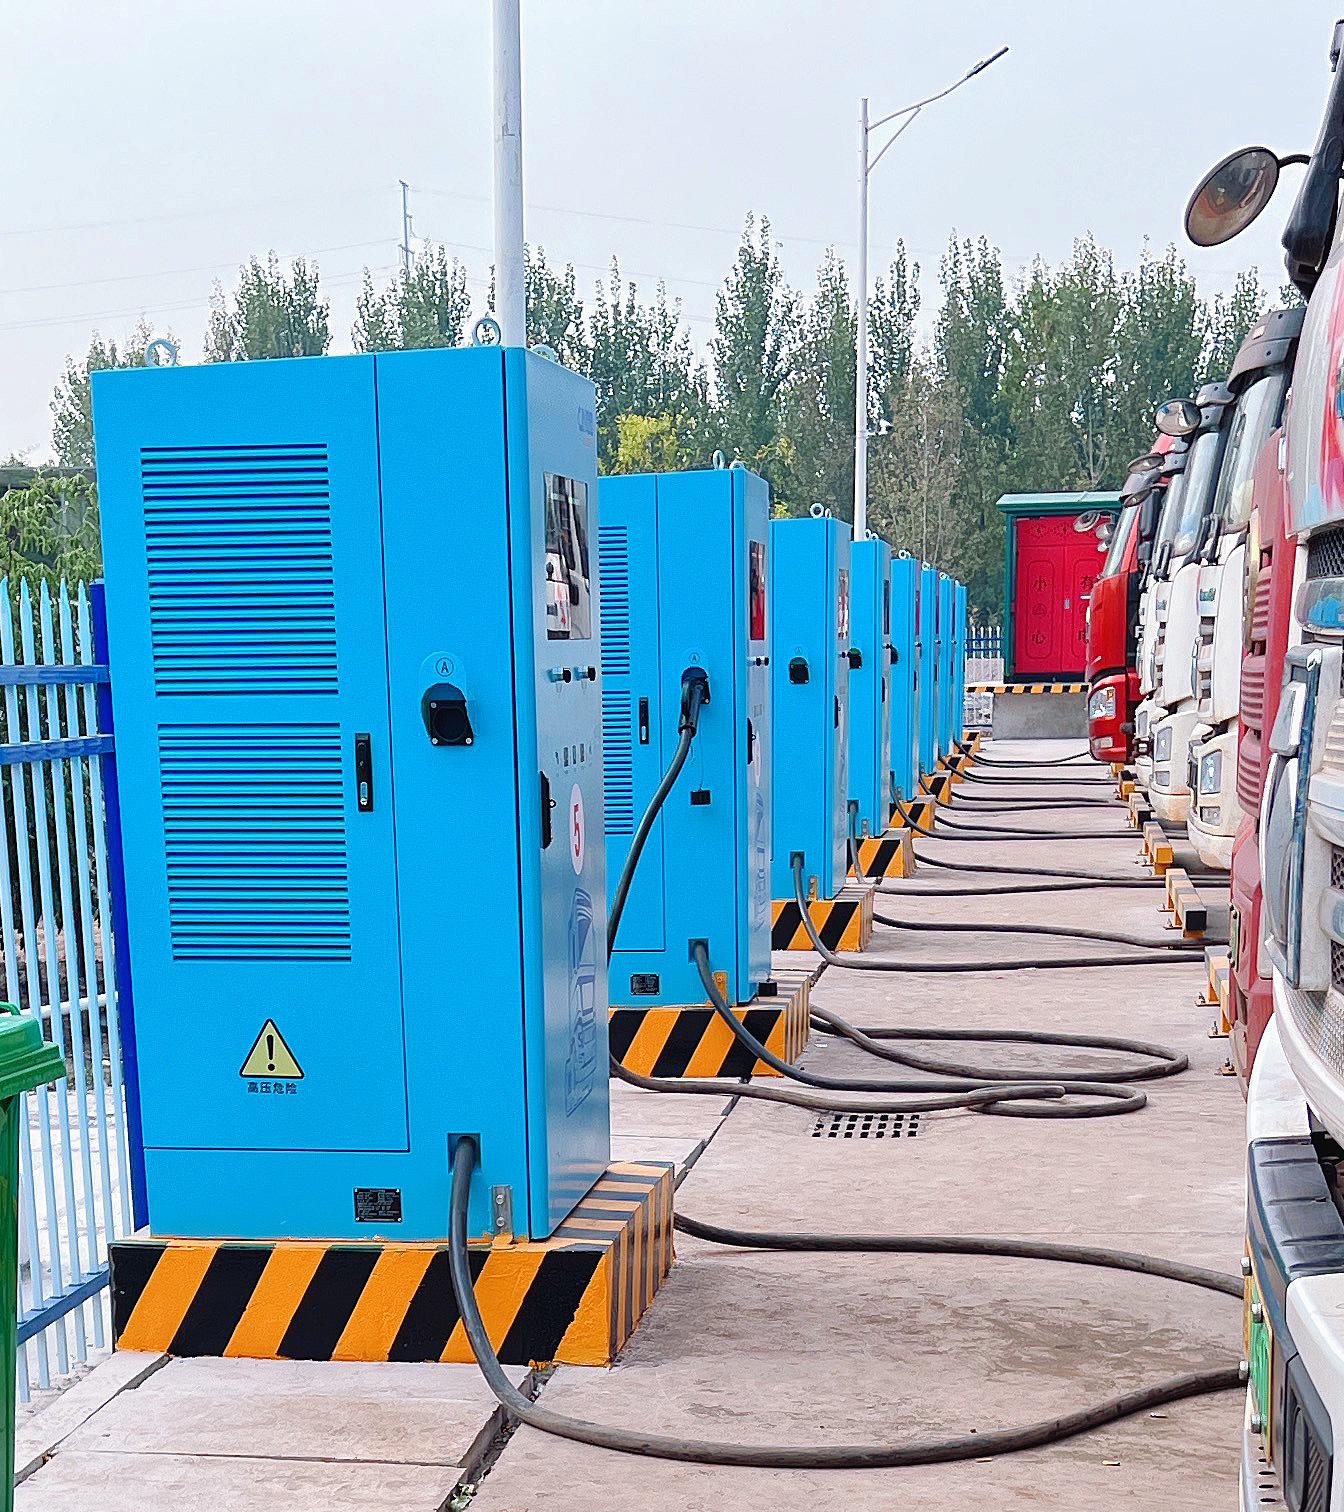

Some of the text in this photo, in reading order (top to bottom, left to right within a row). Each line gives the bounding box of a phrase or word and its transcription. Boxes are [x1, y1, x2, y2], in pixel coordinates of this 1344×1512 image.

[573, 803, 581, 858] 5
[248, 1081, 298, 1095] 高压危险
